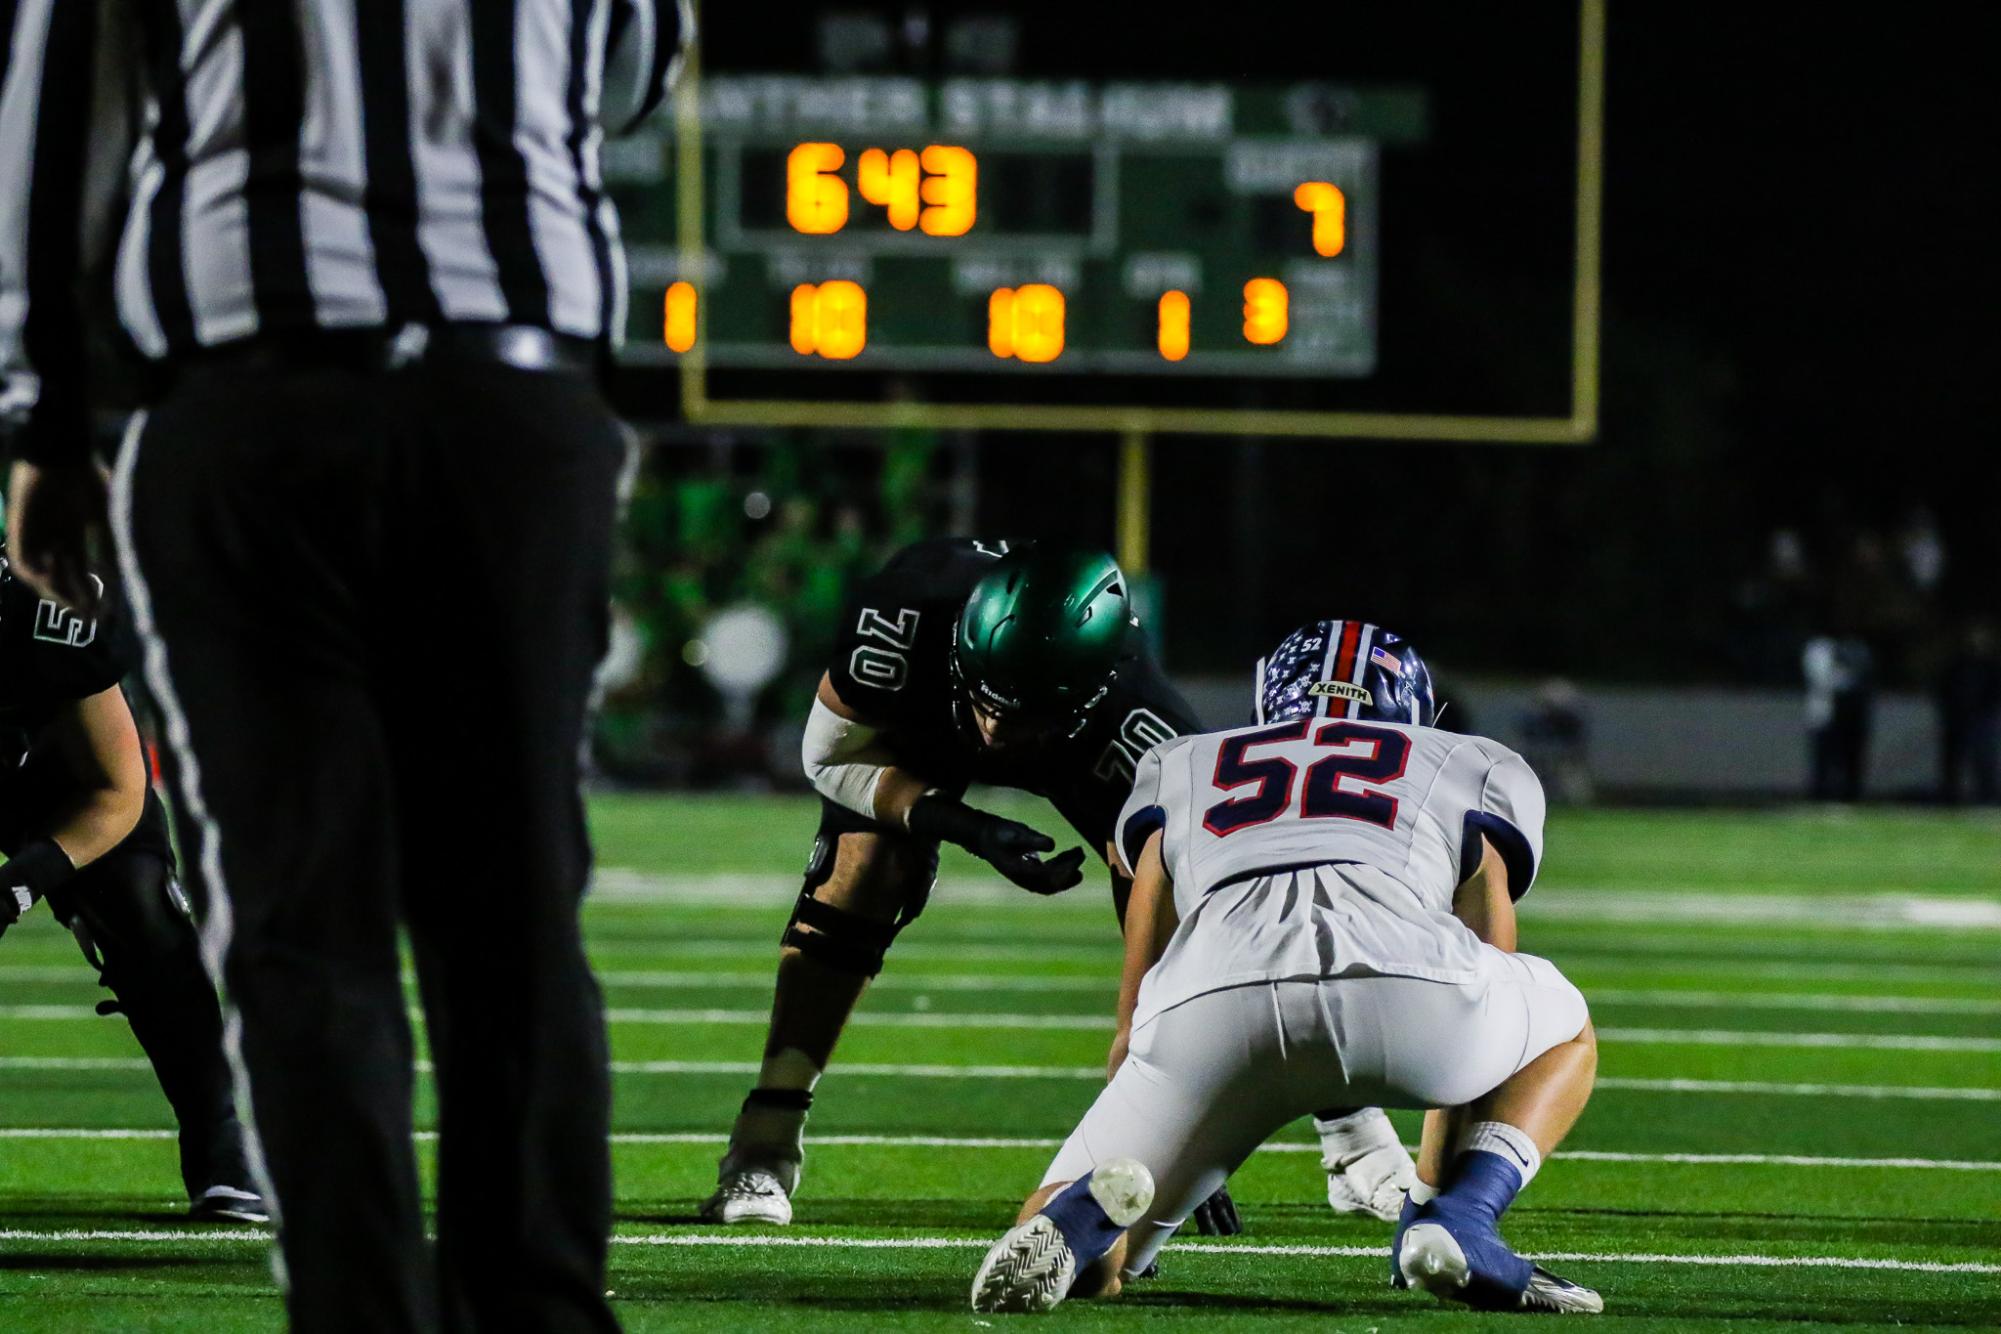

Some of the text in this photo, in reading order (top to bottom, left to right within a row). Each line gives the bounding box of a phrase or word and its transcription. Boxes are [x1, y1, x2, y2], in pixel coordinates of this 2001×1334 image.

[1294, 181, 1345, 257] 7
[849, 607, 921, 692] 70
[1300, 637, 1323, 653] 52
[1315, 683, 1368, 701] XENITH
[1093, 707, 1179, 785] 70
[1202, 718, 1413, 839] 52
